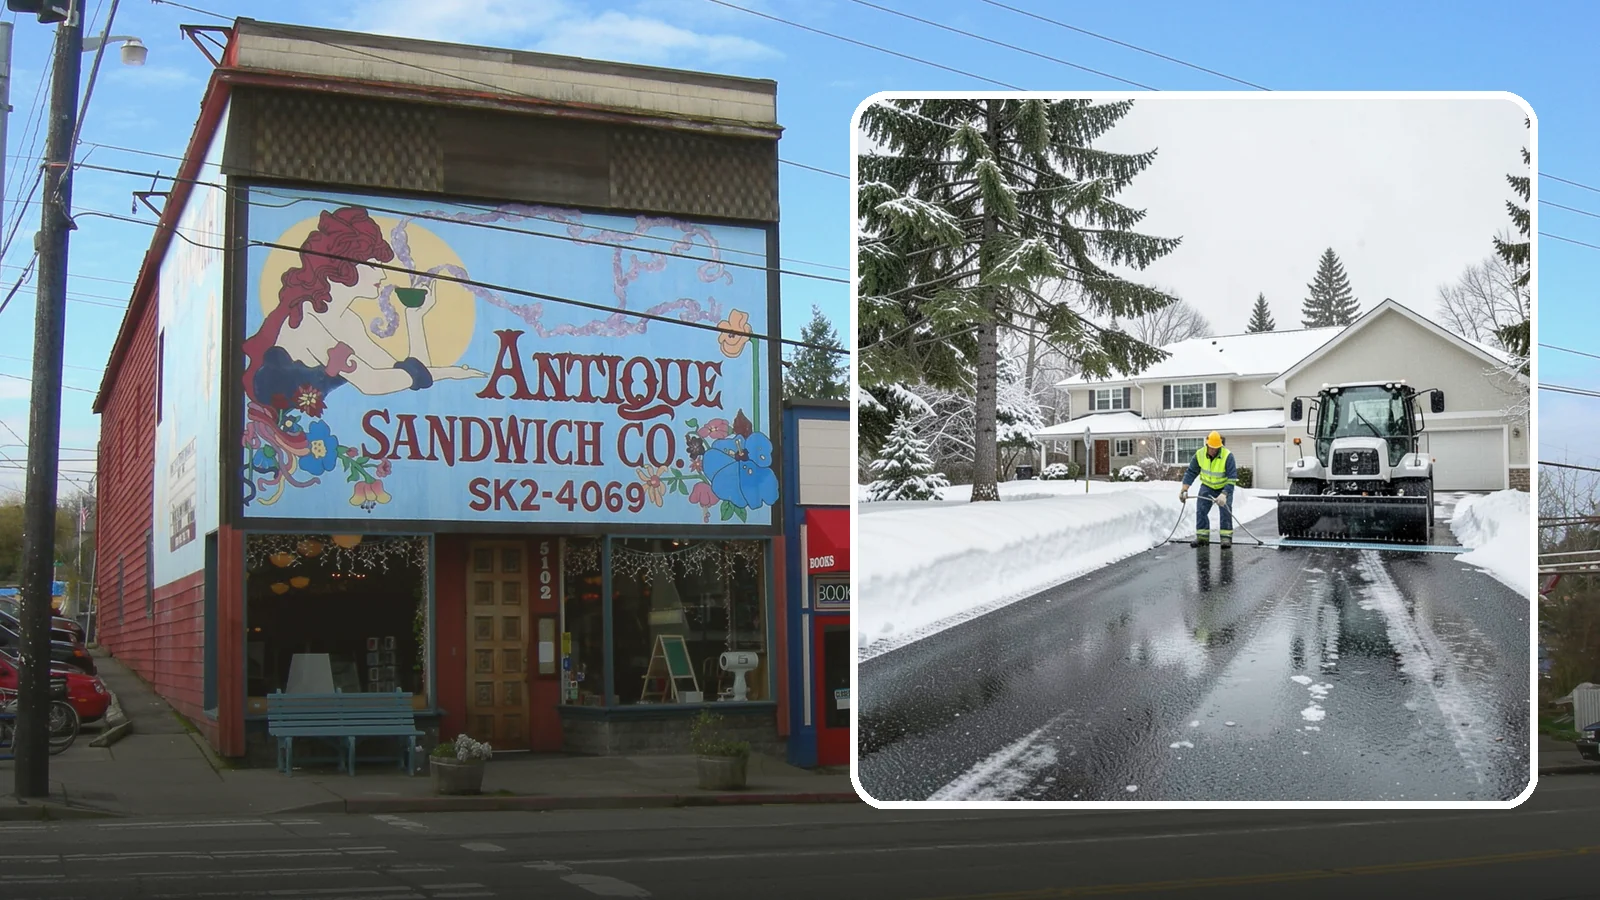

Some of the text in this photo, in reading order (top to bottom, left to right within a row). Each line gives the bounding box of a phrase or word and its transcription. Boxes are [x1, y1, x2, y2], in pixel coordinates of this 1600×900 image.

[476, 330, 723, 421] ANTIQUE
[362, 409, 684, 468] SANDWICH CO.
[468, 476, 645, 513] SK2-4069
[540, 542, 551, 599] 5102
[809, 555, 835, 569] BOOKS
